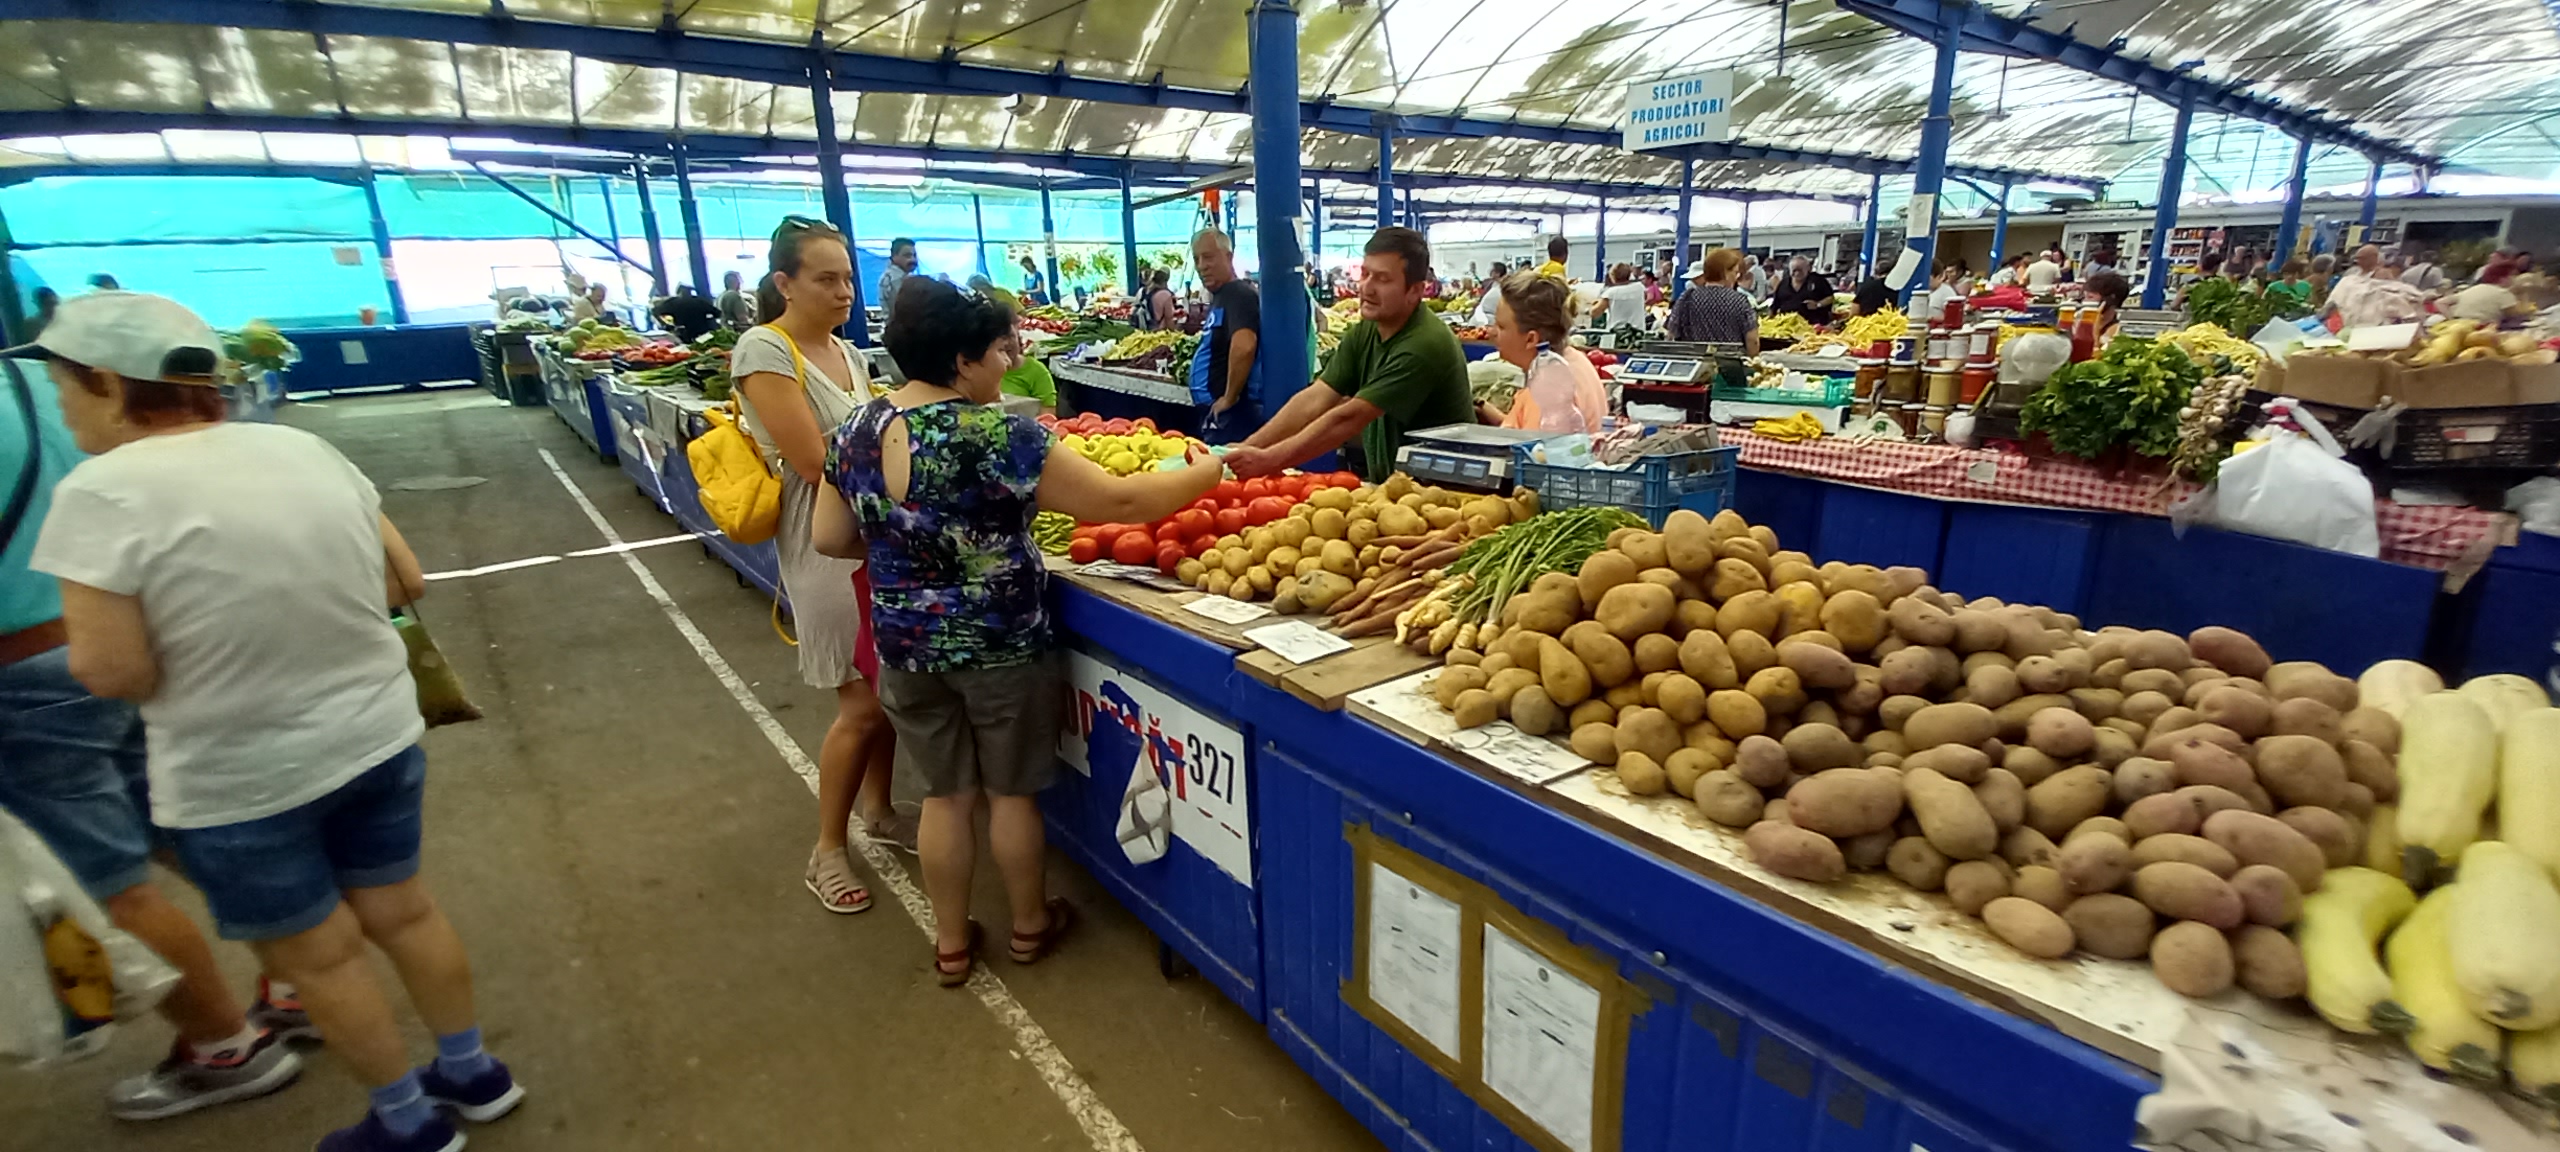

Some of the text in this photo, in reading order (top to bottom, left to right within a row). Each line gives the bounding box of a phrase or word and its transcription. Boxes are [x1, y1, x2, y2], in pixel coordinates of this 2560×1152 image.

[1652, 80, 1702, 101] SECTOR
[1631, 98, 1724, 124] PRODUCĂTORI
[1644, 122, 1705, 143] AGRICOLI
[1187, 733, 1235, 805] 327
